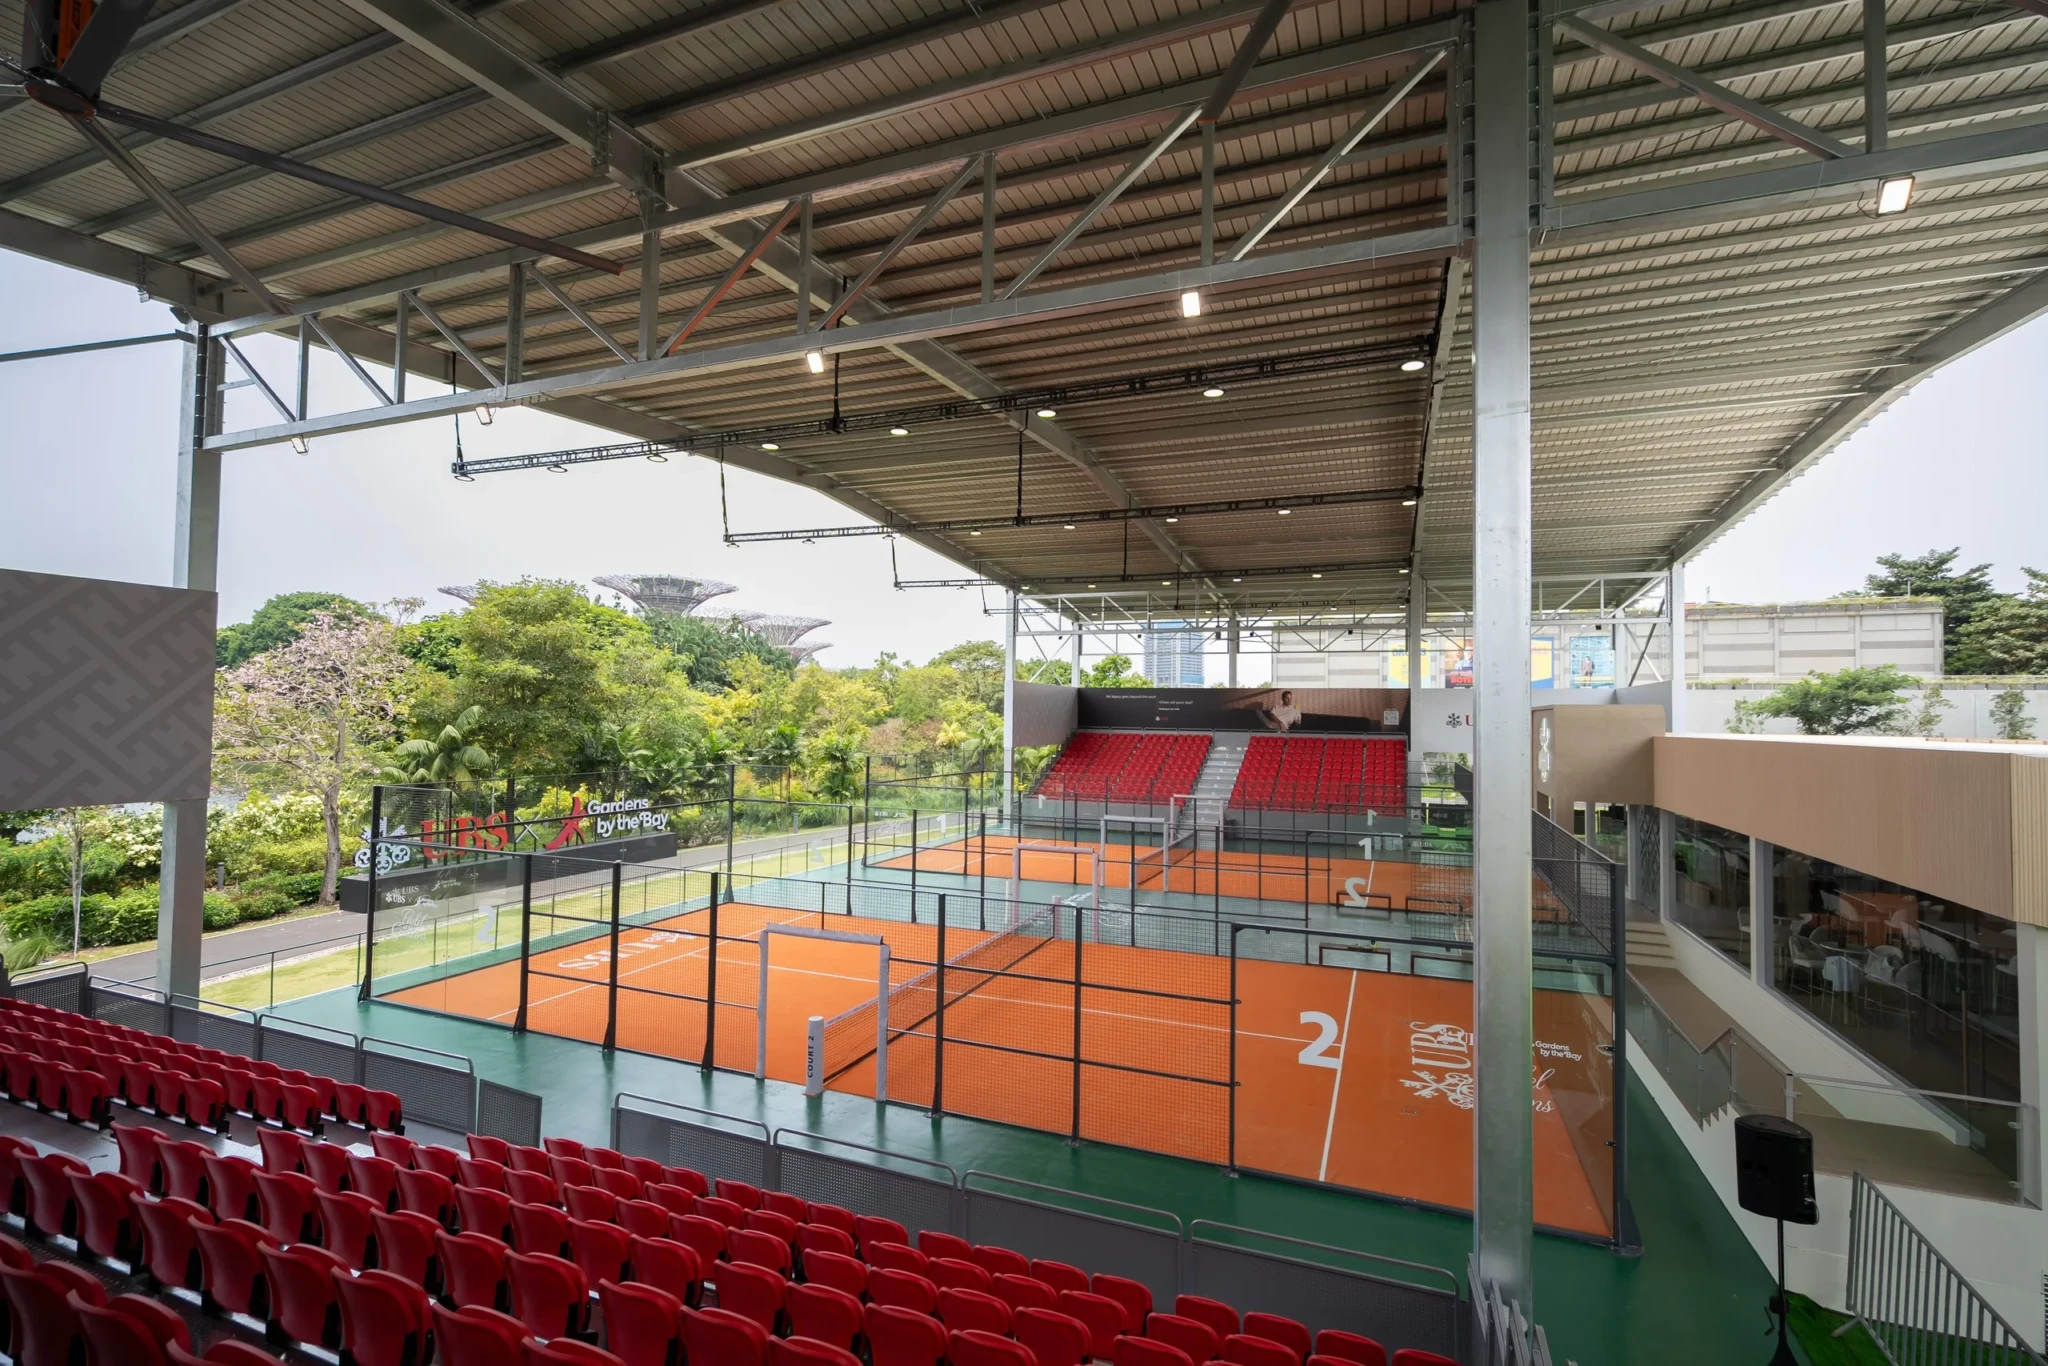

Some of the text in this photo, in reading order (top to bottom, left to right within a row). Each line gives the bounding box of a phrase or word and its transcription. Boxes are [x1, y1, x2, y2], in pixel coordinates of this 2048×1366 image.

[587, 797, 649, 815] Gardens
[597, 811, 669, 838] by the Bay
[420, 813, 509, 859] UBS
[1358, 838, 1372, 860] 1
[401, 884, 420, 894] UBS
[1298, 1011, 1342, 1070] 2
[1410, 1021, 1472, 1069] UBS
[1535, 1040, 1570, 1051] Gardens
[1540, 1048, 1582, 1062] by the Bay
